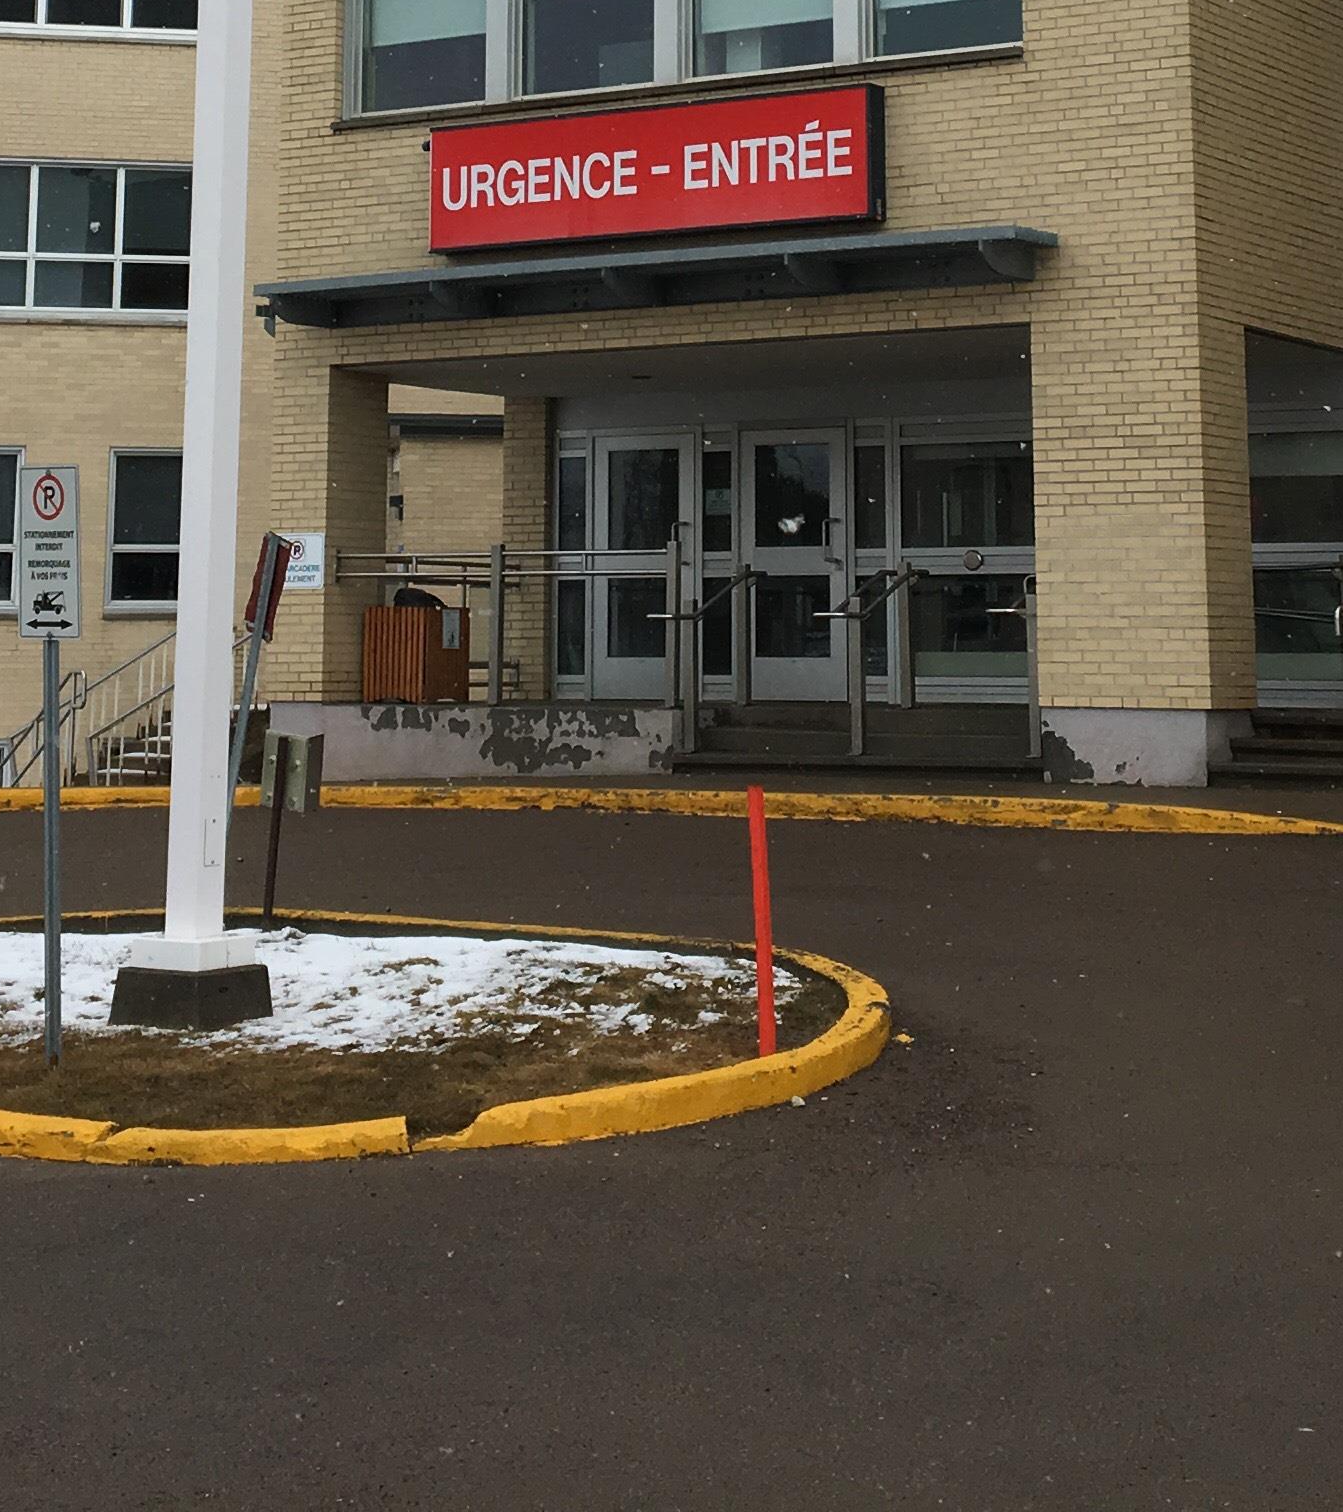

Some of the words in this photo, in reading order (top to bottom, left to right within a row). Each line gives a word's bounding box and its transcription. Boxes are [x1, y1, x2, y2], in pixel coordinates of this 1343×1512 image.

[442, 150, 638, 211] URGENCE
[683, 120, 853, 190] ENTRÉE
[43, 486, 55, 510] P
[24, 530, 74, 539] STATIONNEMENT
[35, 543, 63, 551] INTERDIT
[27, 560, 71, 568] REMORQUAGE
[36, 571, 49, 580] VOS
[49, 571, 68, 580] FRS
